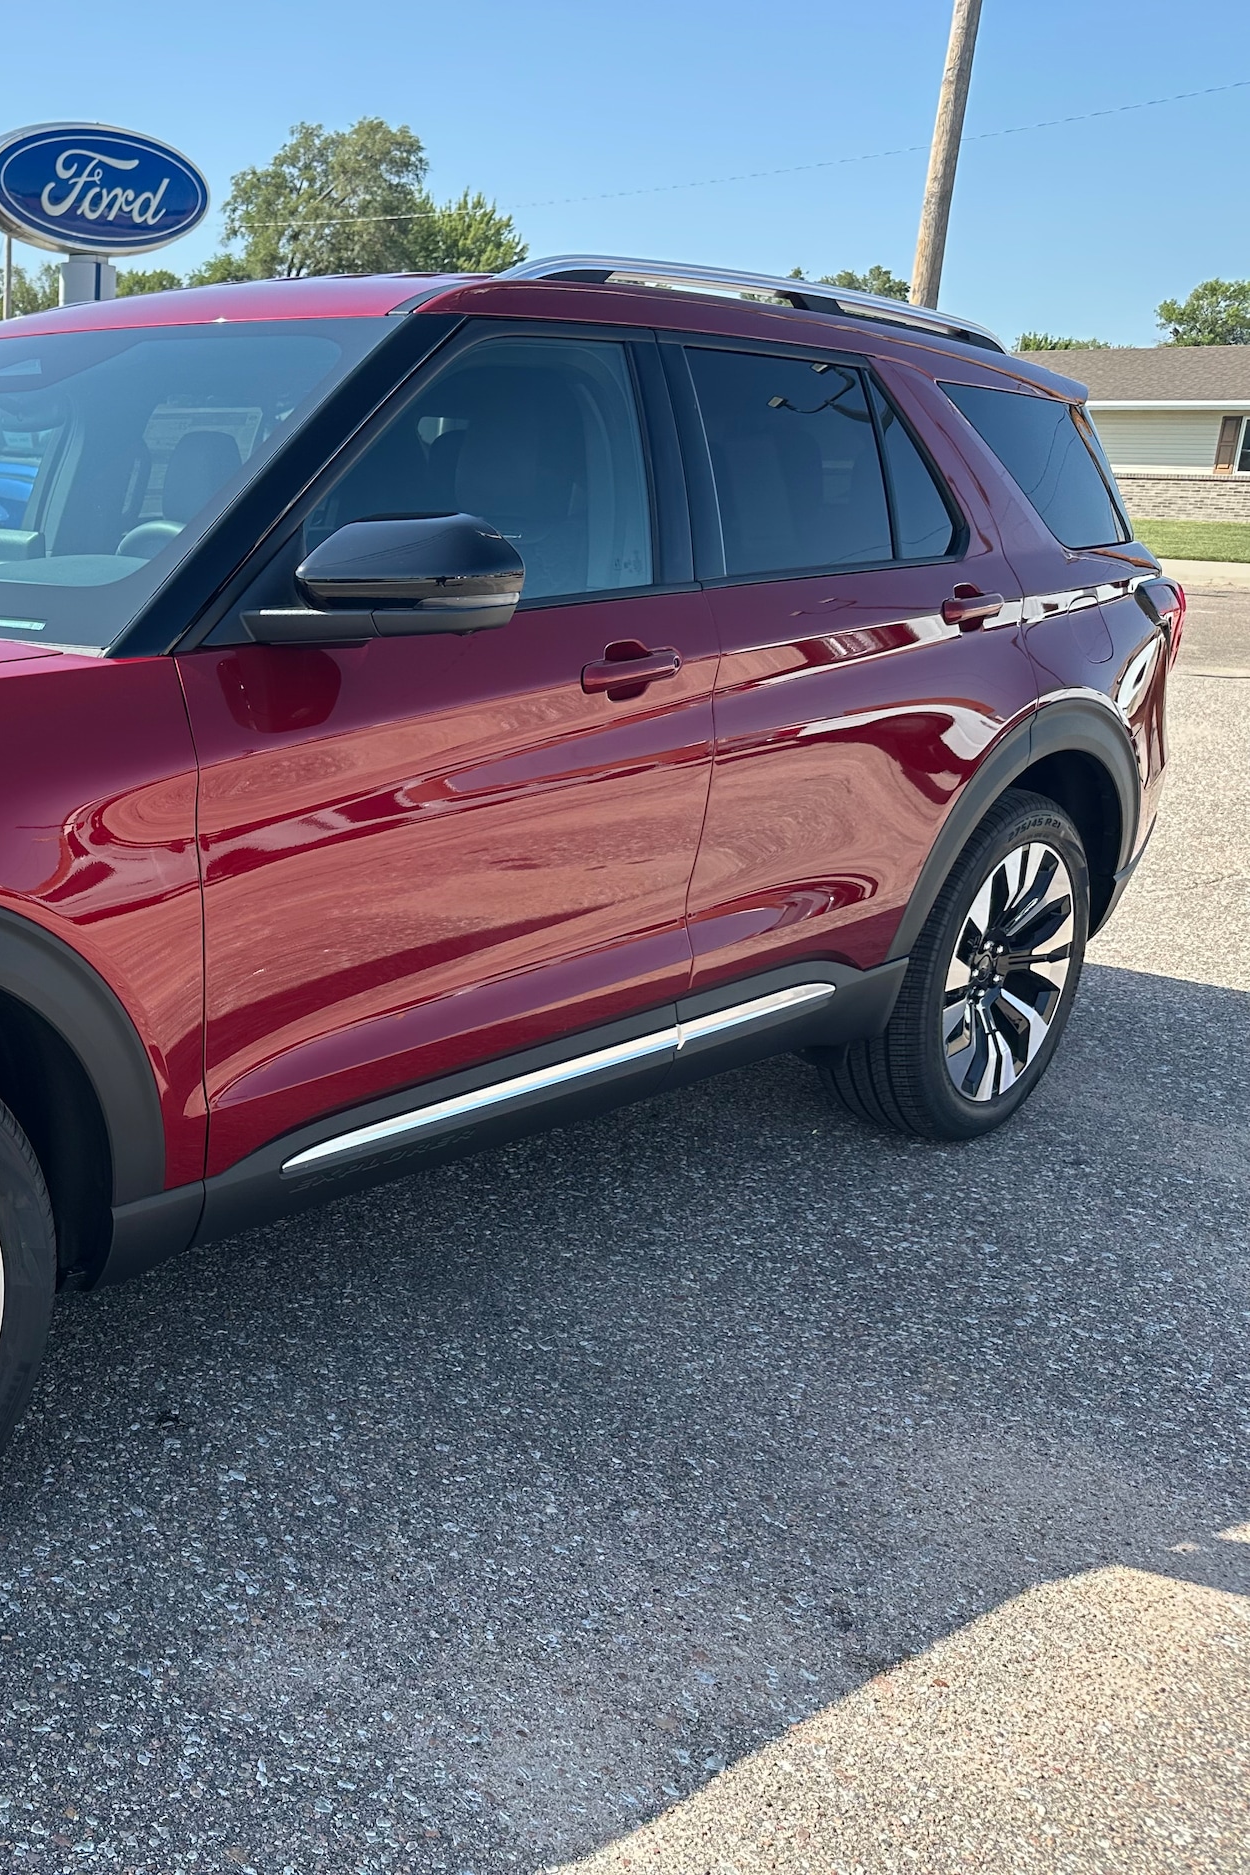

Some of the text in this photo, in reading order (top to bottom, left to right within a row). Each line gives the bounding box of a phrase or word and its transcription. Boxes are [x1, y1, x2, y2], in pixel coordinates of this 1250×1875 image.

[40, 148, 170, 226] Ford
[1008, 817, 1044, 841] 275/45
[288, 1127, 477, 1194] EXPLORER
